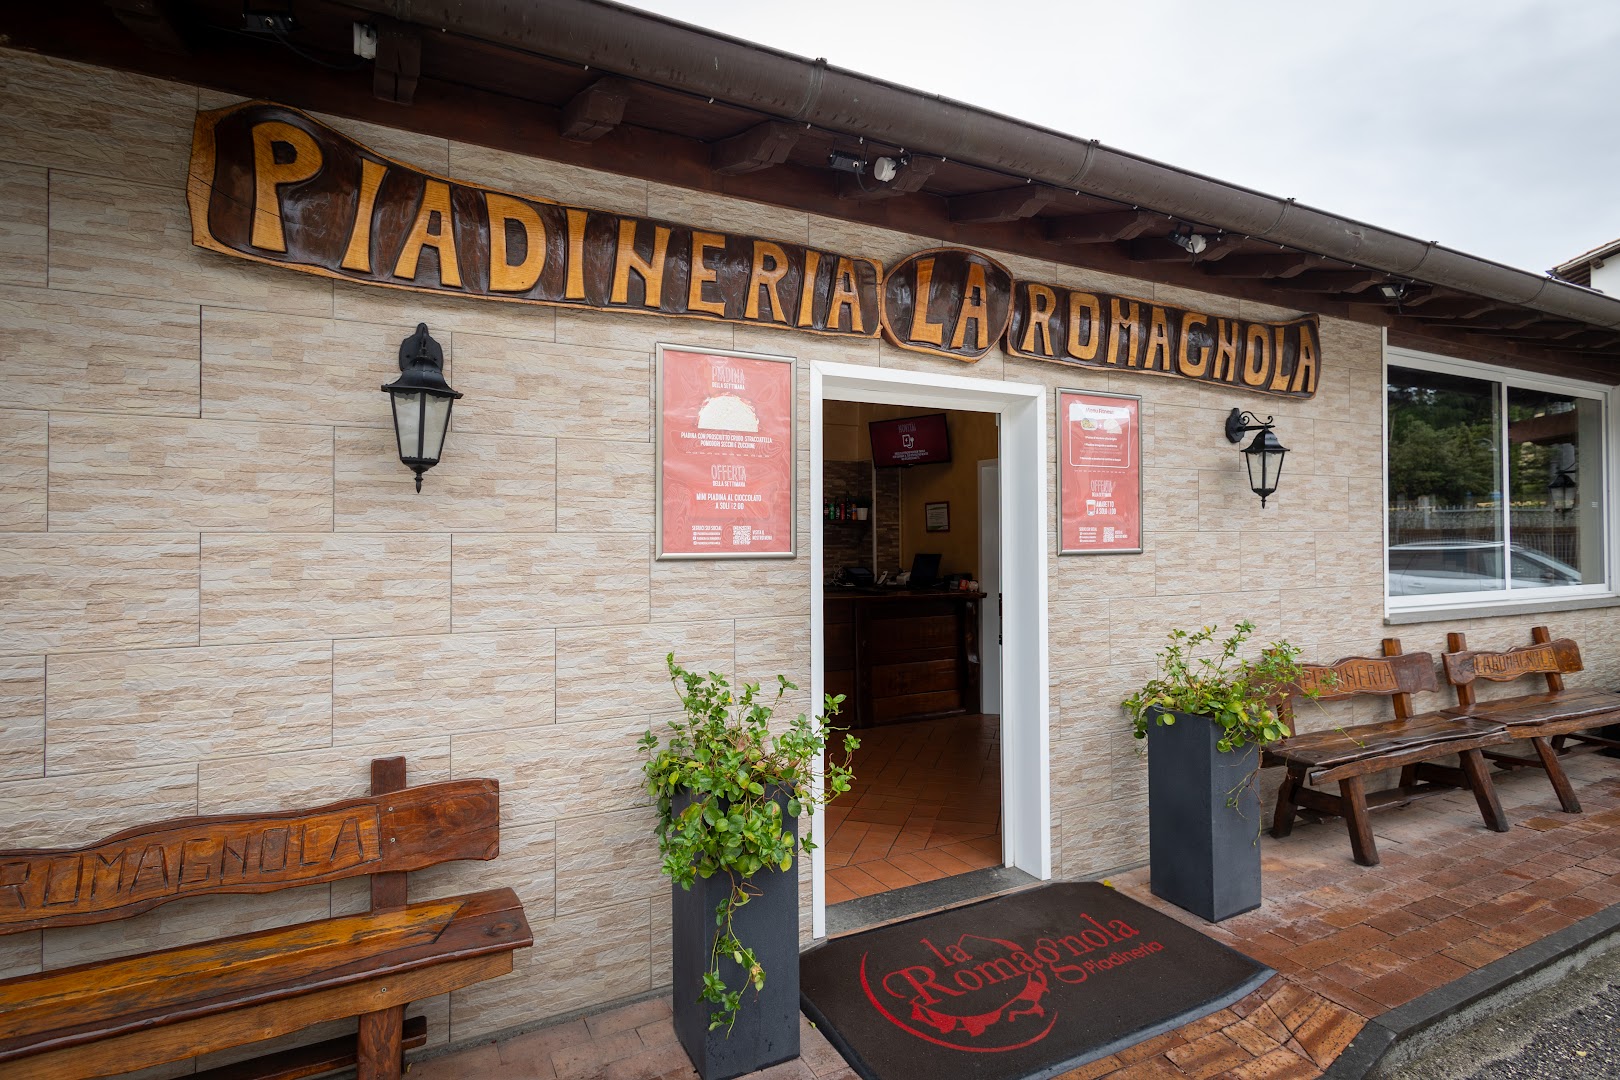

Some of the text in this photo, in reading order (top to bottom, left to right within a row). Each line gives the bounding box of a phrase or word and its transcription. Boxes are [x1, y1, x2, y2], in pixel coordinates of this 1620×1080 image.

[251, 121, 1316, 393] PIADINERIA LA ROMAGNOLA
[710, 464, 747, 481] OFFERTA
[696, 493, 707, 501] MINI
[707, 493, 727, 501] PIADINA
[734, 494, 762, 502] CIOCCOLATO
[882, 912, 1140, 1007] Romagnola
[920, 937, 973, 968] la
[1085, 940, 1165, 975] Piadineria
